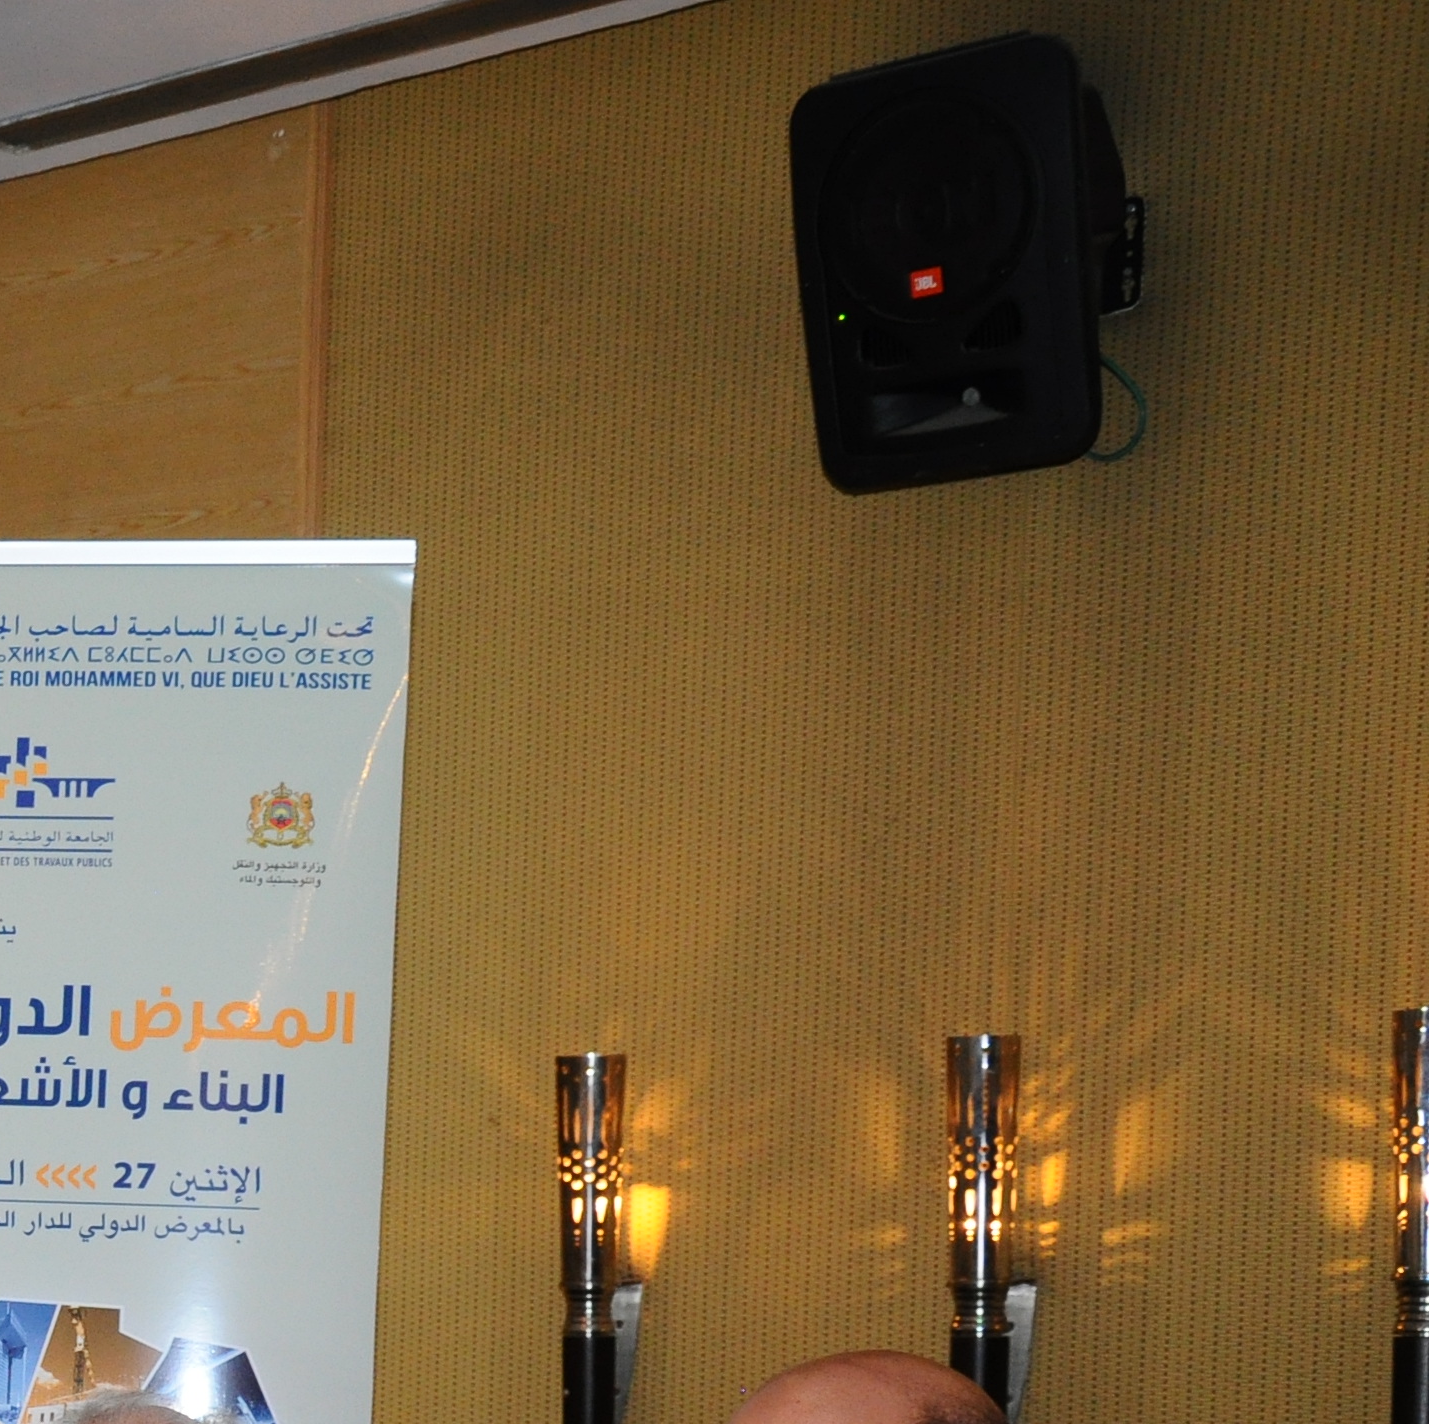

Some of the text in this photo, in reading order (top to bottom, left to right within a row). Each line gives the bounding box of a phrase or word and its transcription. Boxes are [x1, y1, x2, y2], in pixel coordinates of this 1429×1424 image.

[914, 275, 938, 291] JBL
[28, 614, 118, 643] لصاحب
[127, 615, 225, 642] السامية
[234, 615, 318, 644] الرعاية
[326, 616, 374, 638] تحت
[10, 670, 40, 687] ROI
[44, 670, 156, 688] MOHAMMED
[162, 671, 185, 689] VI,
[190, 671, 226, 689] QUE
[232, 671, 274, 688] DIEU
[279, 671, 372, 690] L'ASSISTE
[109, 985, 357, 1053] المعرض
[121, 1080, 148, 1120] و
[162, 1070, 285, 1125] البناء
[113, 1161, 157, 1190] 27
[23, 1211, 72, 1237] للدار
[78, 1213, 146, 1243] الدولي
[154, 1215, 245, 1244] بالمعرض
